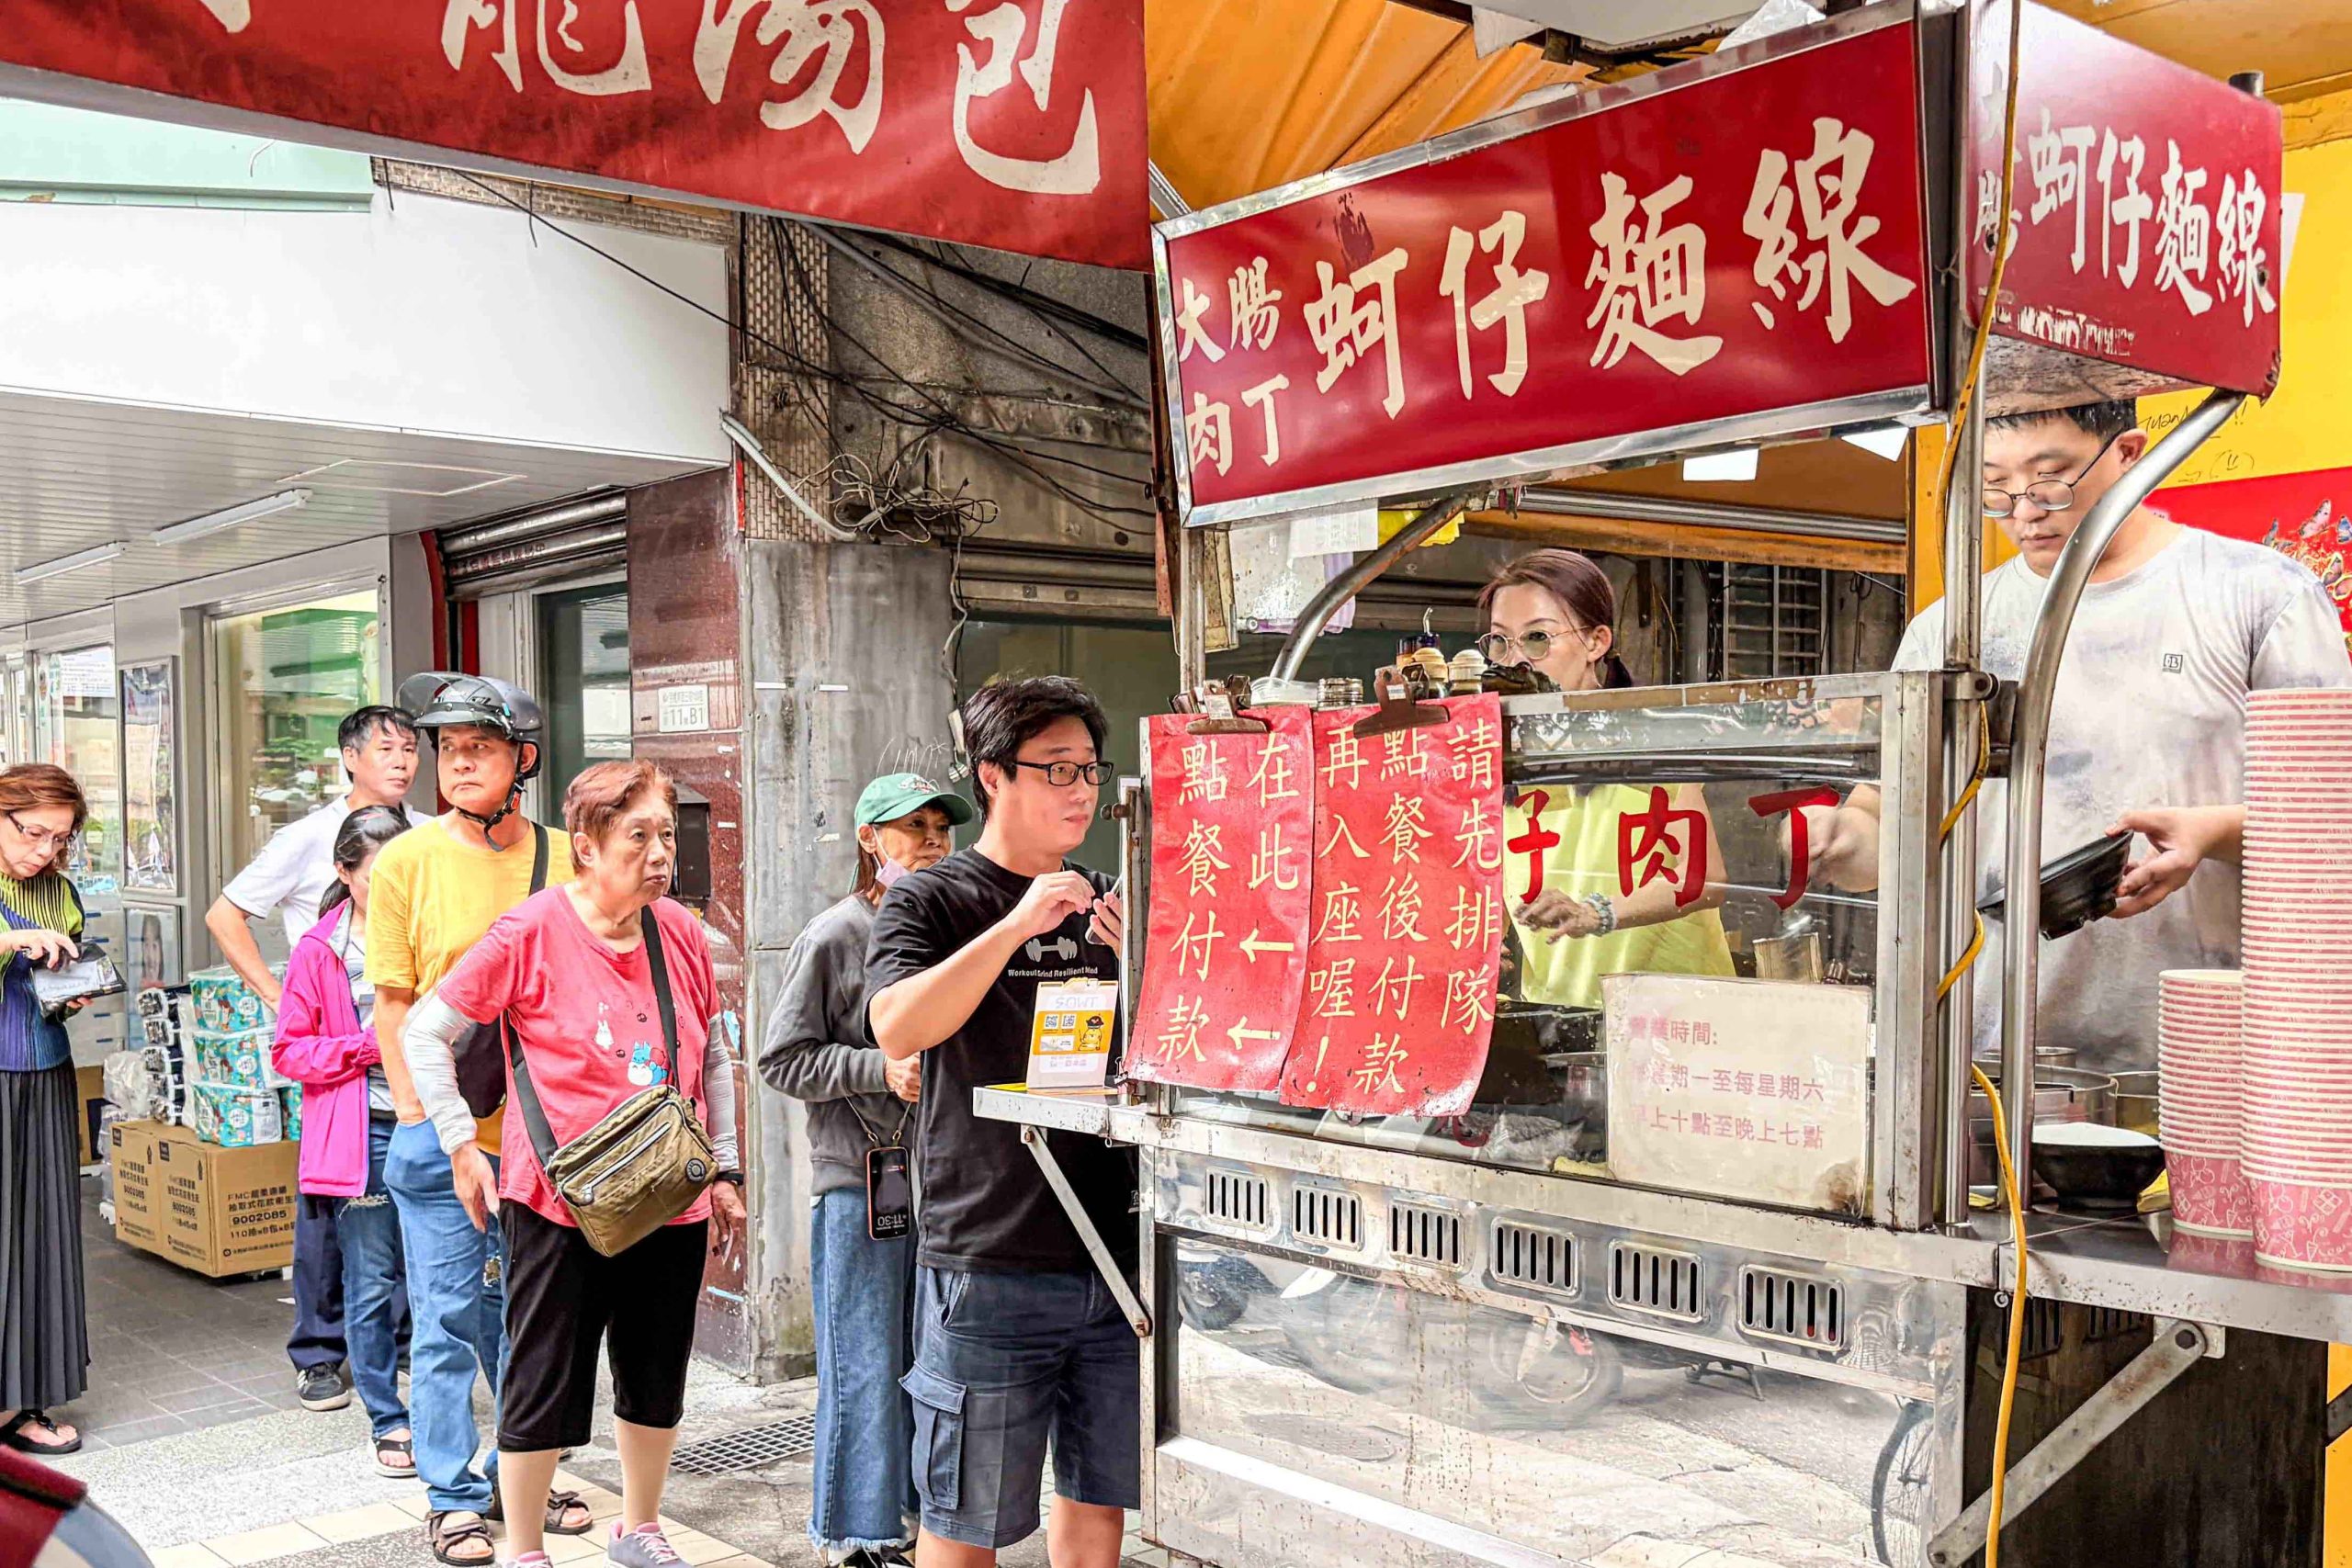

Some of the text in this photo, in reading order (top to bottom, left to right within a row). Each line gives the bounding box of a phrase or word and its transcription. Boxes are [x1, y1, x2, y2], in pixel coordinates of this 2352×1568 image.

[1304, 116, 1917, 421] 蚵仔麵線
[2029, 107, 2277, 328] 蚵仔麵線
[1177, 255, 1283, 362] 大腸
[1186, 373, 1290, 478] 肉丁
[1246, 732, 1299, 891] 在此
[1441, 717, 1502, 1035] 請先排隊
[1054, 967, 1084, 977] Resilient
[1154, 741, 1230, 1062] 點餐付款
[1352, 726, 1433, 1094] 點餐後付款
[1632, 1106, 1825, 1150] 上十點至晚上七點
[232, 1210, 288, 1225] 9002085
